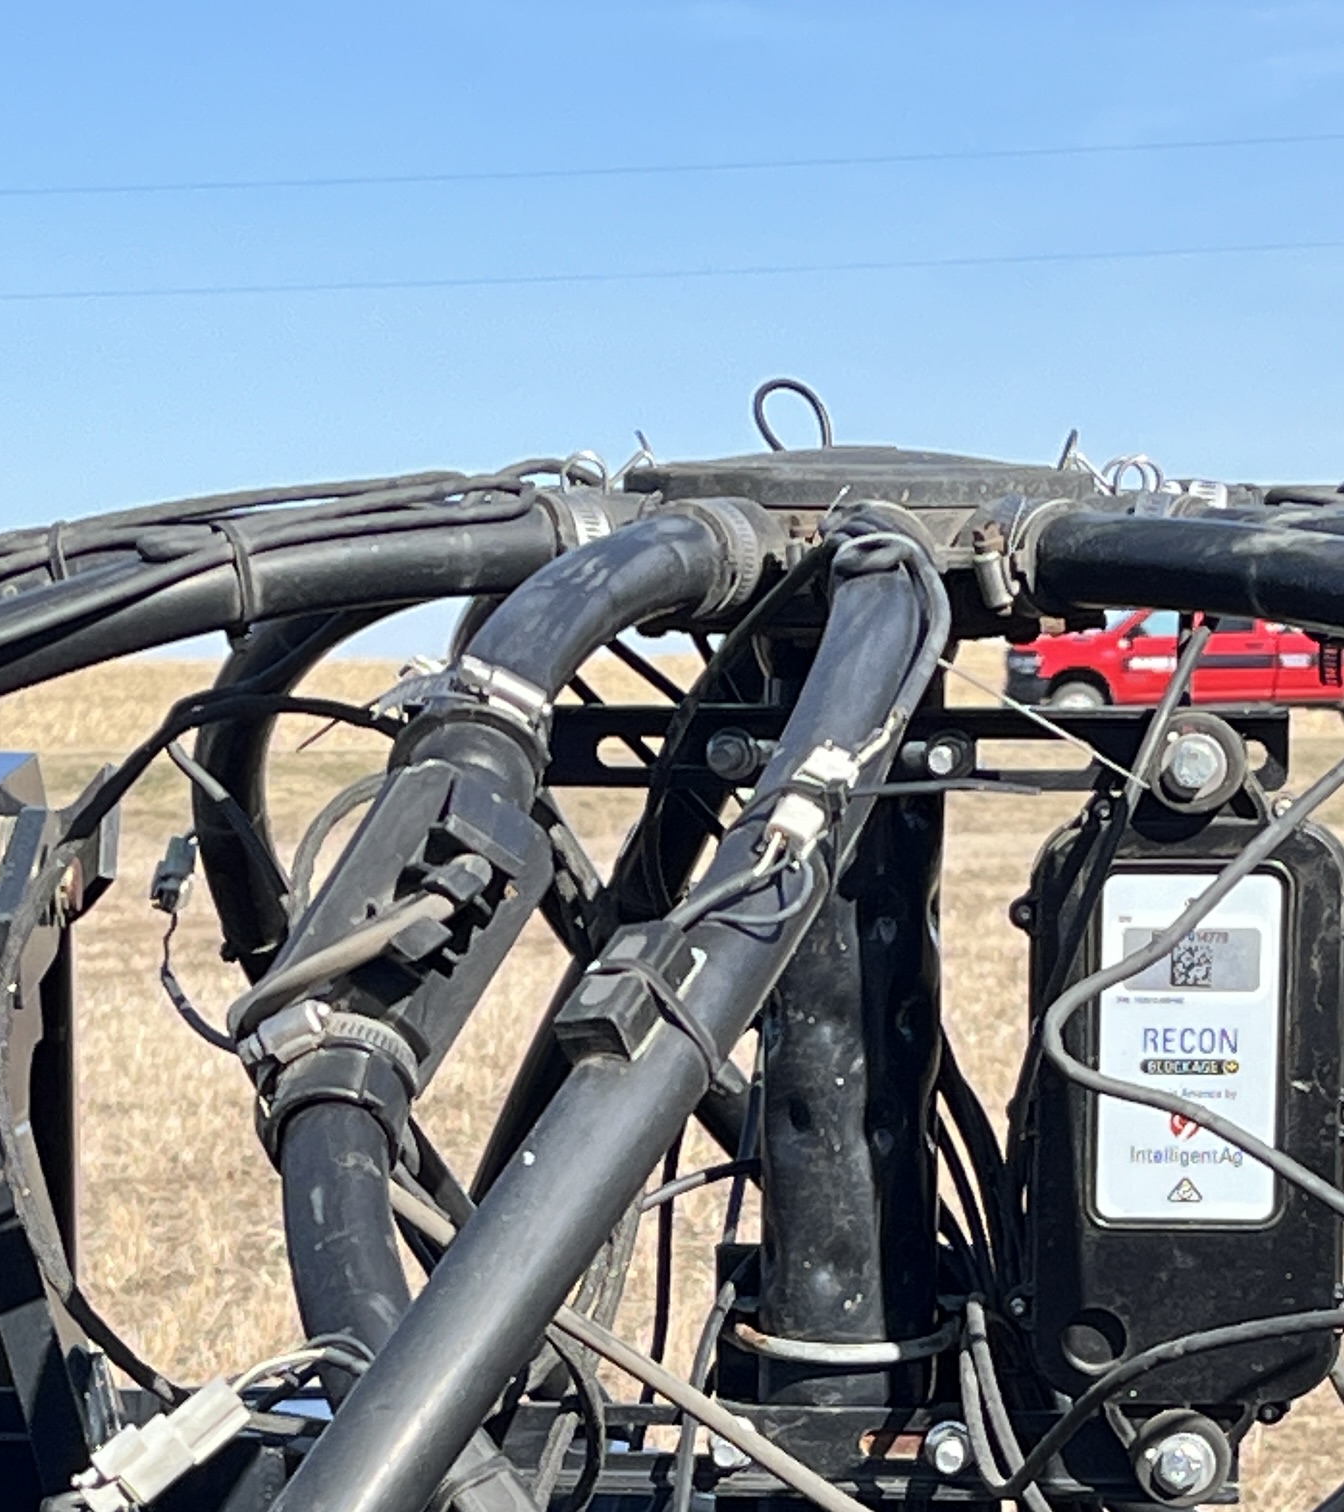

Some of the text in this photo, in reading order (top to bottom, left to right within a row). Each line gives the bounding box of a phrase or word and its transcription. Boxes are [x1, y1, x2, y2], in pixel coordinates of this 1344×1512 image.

[1142, 1027, 1238, 1054] RECON
[1147, 1060, 1219, 1074] BLOCKAGE
[1129, 1146, 1244, 1168] IntelligentAg
